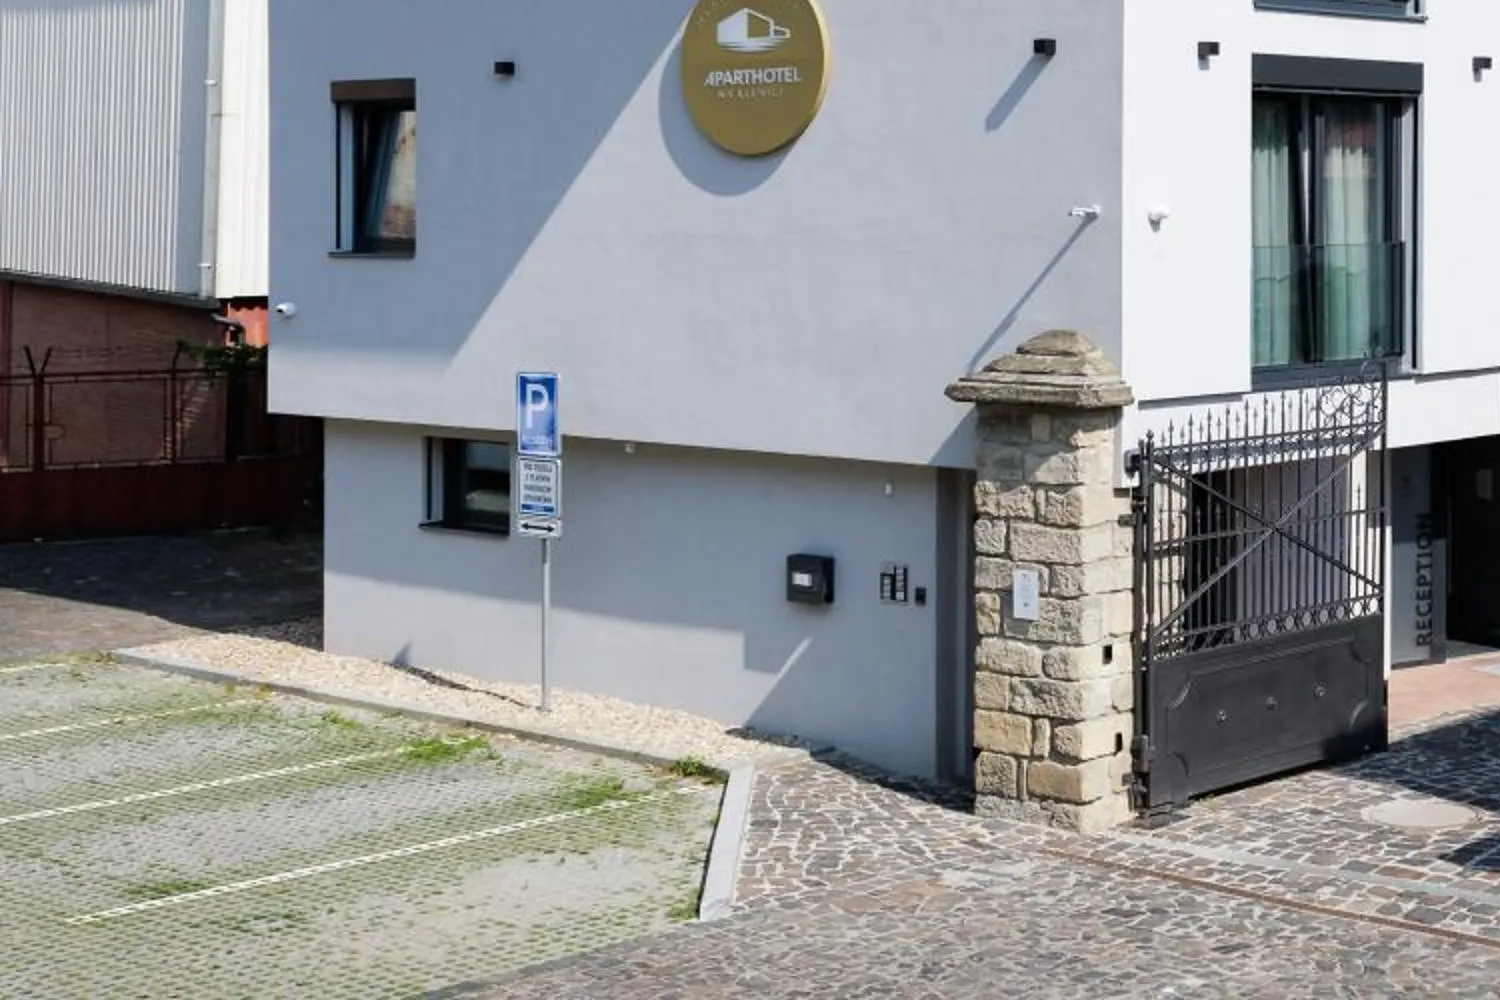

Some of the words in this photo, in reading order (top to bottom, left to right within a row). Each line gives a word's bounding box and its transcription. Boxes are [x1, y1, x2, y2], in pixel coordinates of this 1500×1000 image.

[704, 67, 802, 87] APARTHOTEL
[525, 383, 549, 429] P
[1415, 513, 1433, 647] RECEPTION
